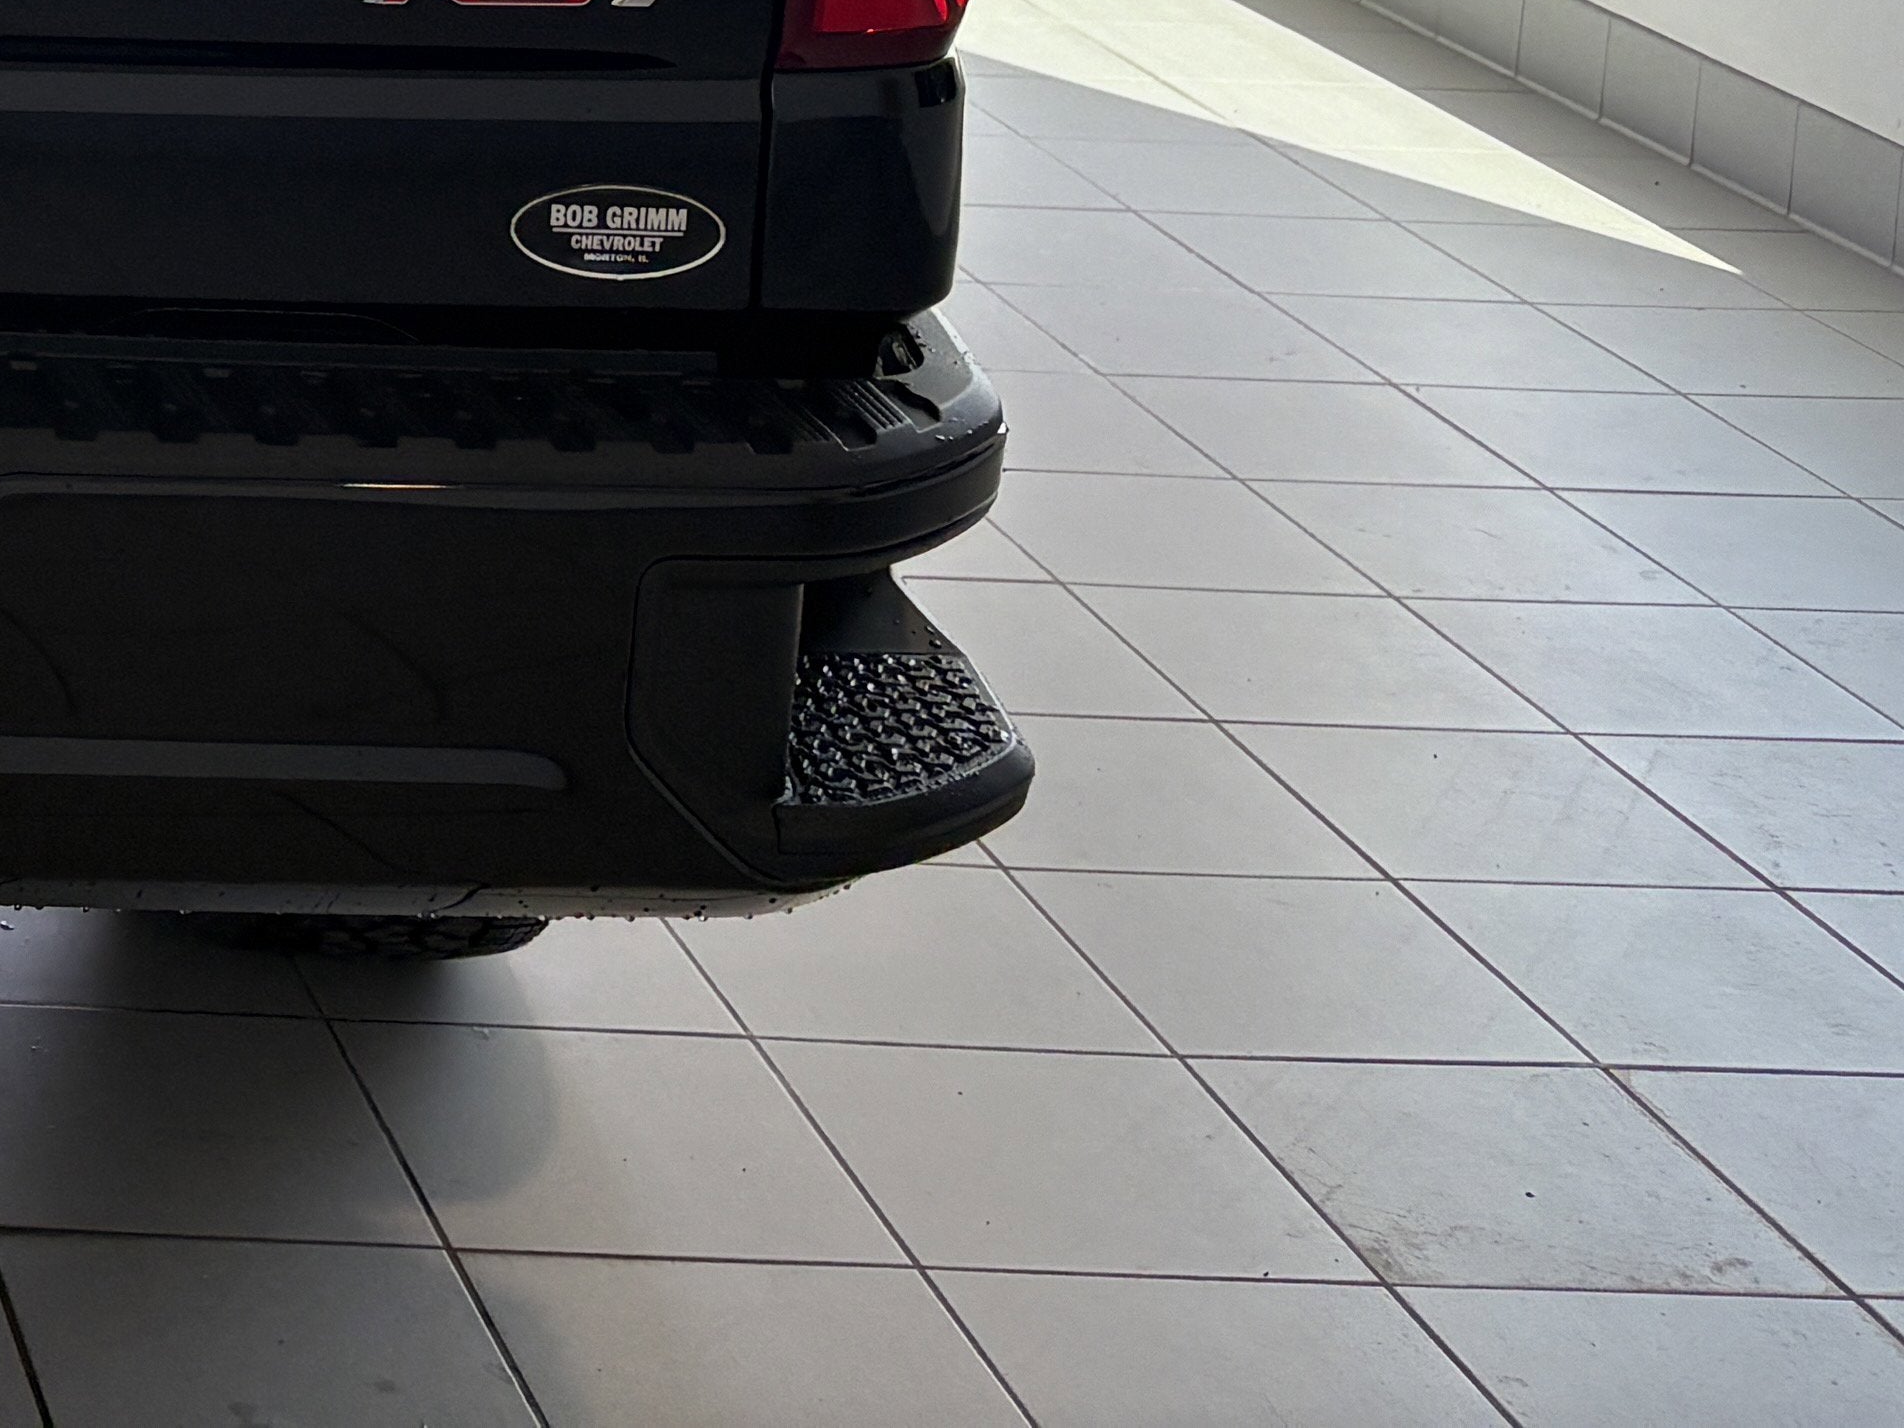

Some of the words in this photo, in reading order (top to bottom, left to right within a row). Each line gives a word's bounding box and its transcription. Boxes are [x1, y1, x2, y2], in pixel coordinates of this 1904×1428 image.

[549, 203, 599, 229] BOB
[605, 206, 689, 231] GRIMM
[570, 234, 664, 253] CHEVROLET
